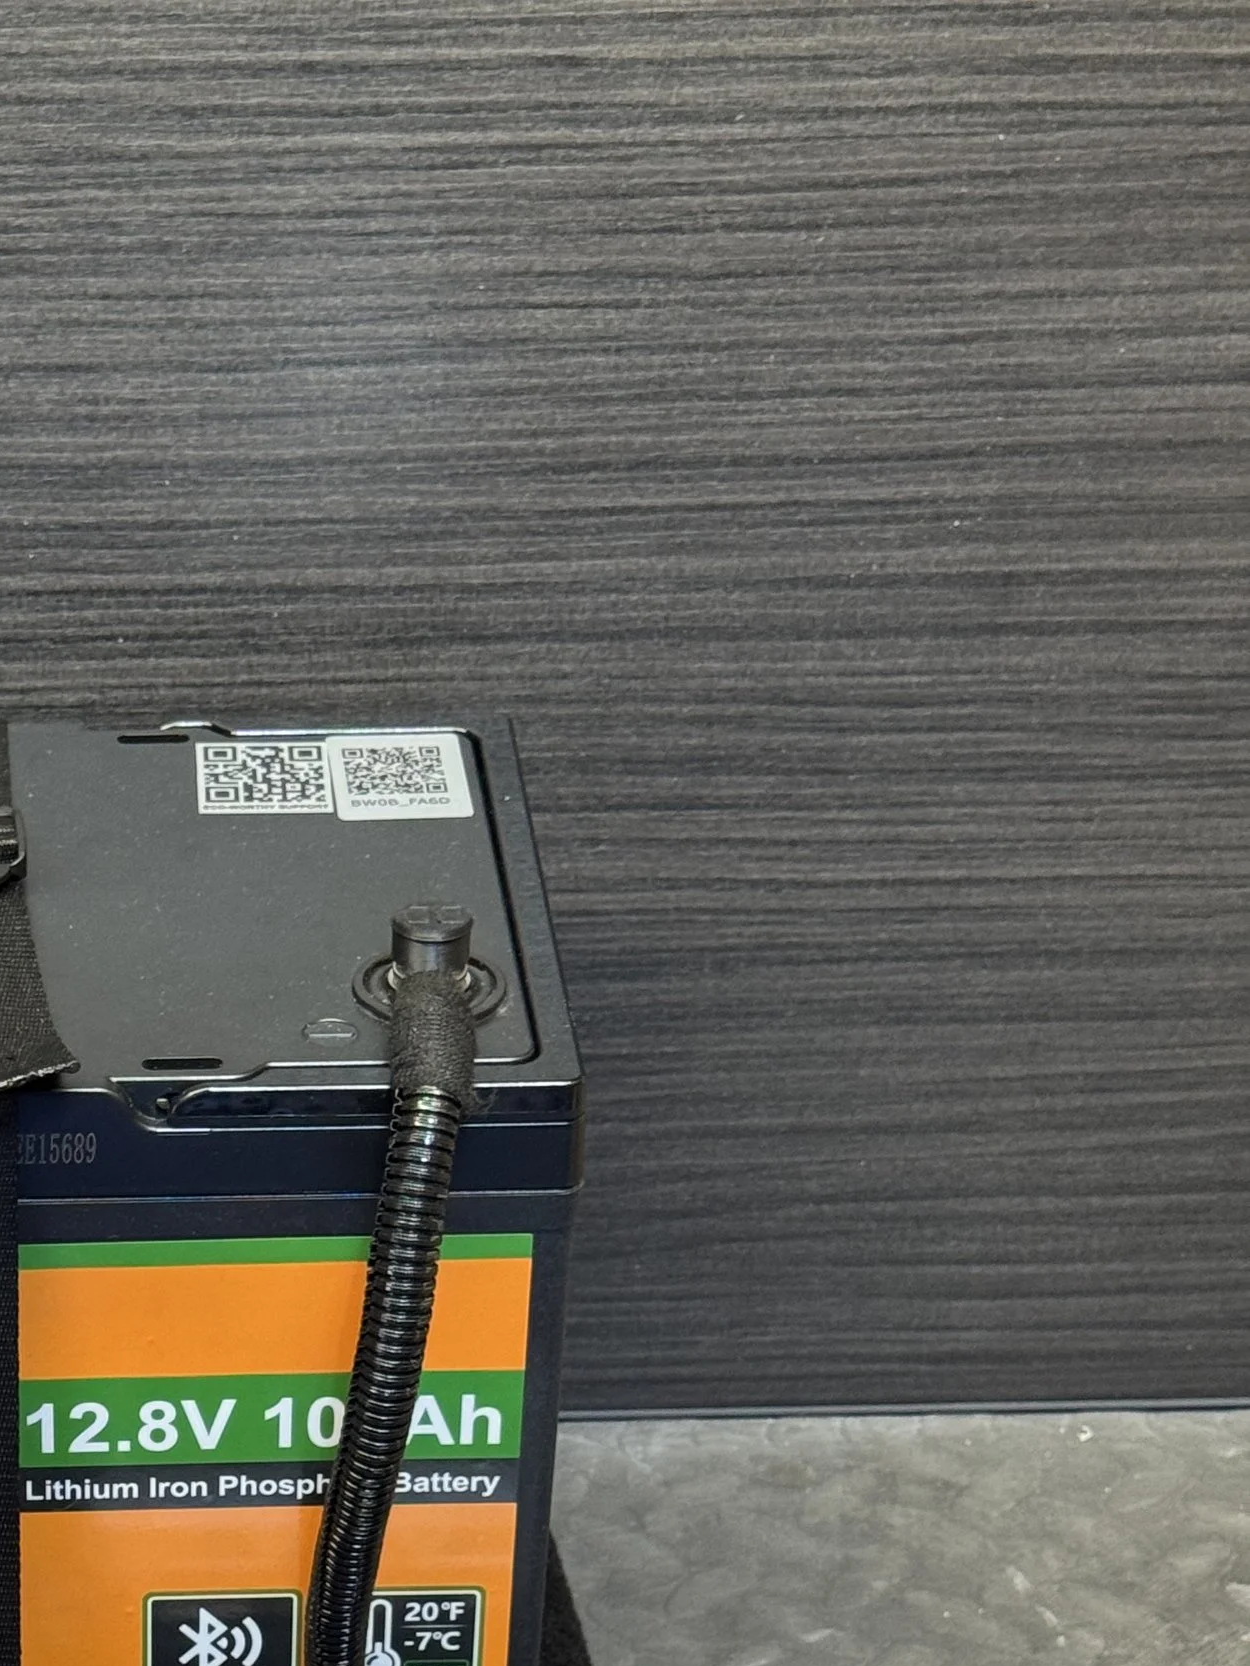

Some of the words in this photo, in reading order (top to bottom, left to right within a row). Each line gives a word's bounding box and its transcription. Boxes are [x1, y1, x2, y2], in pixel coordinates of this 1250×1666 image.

[25, 1398, 237, 1454] 12.8V
[264, 1394, 503, 1449] 10Ah
[25, 1478, 139, 1501] Lithium
[150, 1476, 209, 1499] Iron
[218, 1472, 331, 1501] Phosph
[393, 1471, 501, 1497] Battery
[404, 1601, 466, 1622] 20°F
[404, 1631, 461, 1651] -7°C
